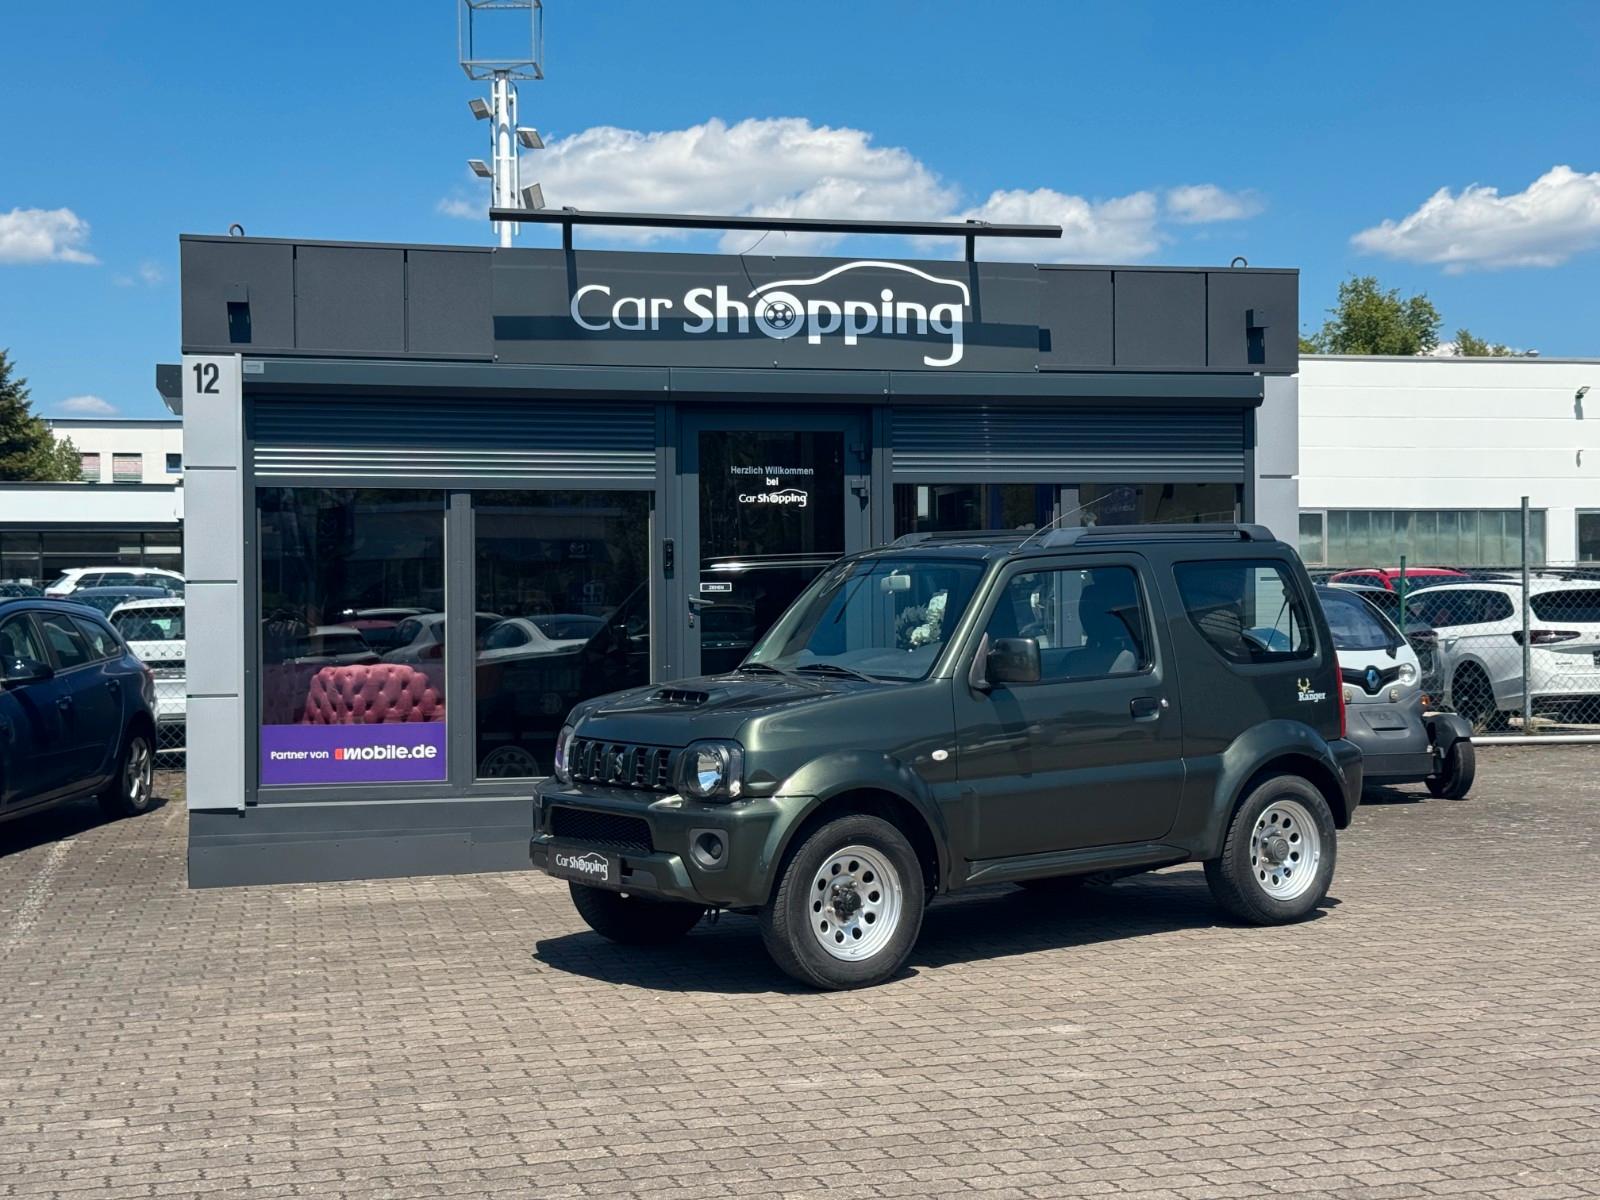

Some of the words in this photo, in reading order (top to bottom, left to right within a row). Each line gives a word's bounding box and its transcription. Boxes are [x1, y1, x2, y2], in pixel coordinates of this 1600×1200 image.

[570, 284, 673, 332] Car
[683, 284, 964, 367] Shopping
[193, 362, 220, 394] 12
[730, 465, 763, 475] Herzlich
[765, 466, 814, 475] Willkommen
[766, 477, 779, 486] bei
[738, 493, 756, 503] Car
[757, 493, 807, 507] Shopping
[1297, 691, 1326, 703] Ranger
[270, 751, 308, 760] Partner
[310, 750, 329, 759] von
[343, 744, 438, 760] mobile.de
[555, 853, 569, 867] Car
[569, 856, 609, 881] Shopping
